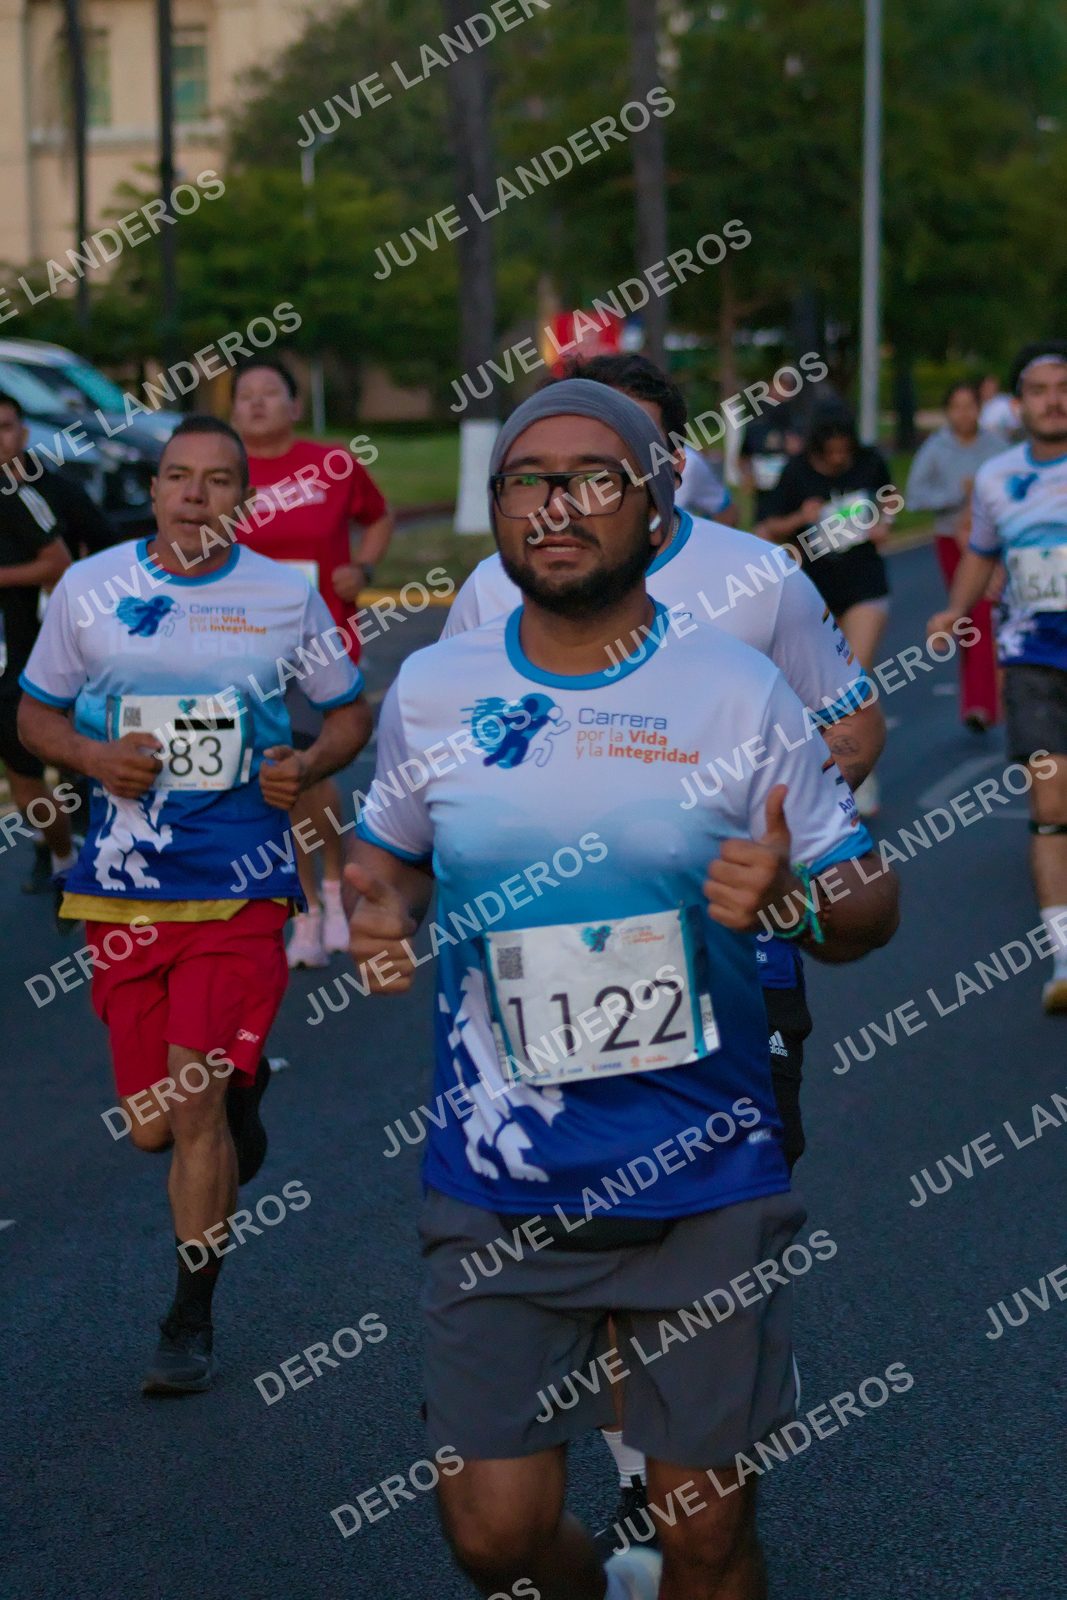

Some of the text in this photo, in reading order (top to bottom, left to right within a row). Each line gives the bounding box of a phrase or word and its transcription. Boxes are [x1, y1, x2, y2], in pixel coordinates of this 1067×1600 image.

[189, 604, 246, 616] Carrera
[210, 624, 267, 635] Integridad
[222, 616, 247, 625] Vida
[578, 708, 668, 730] Carrera
[576, 728, 668, 746] por la Vida
[576, 743, 699, 764] y la Integridad
[508, 979, 687, 1060] 1122
